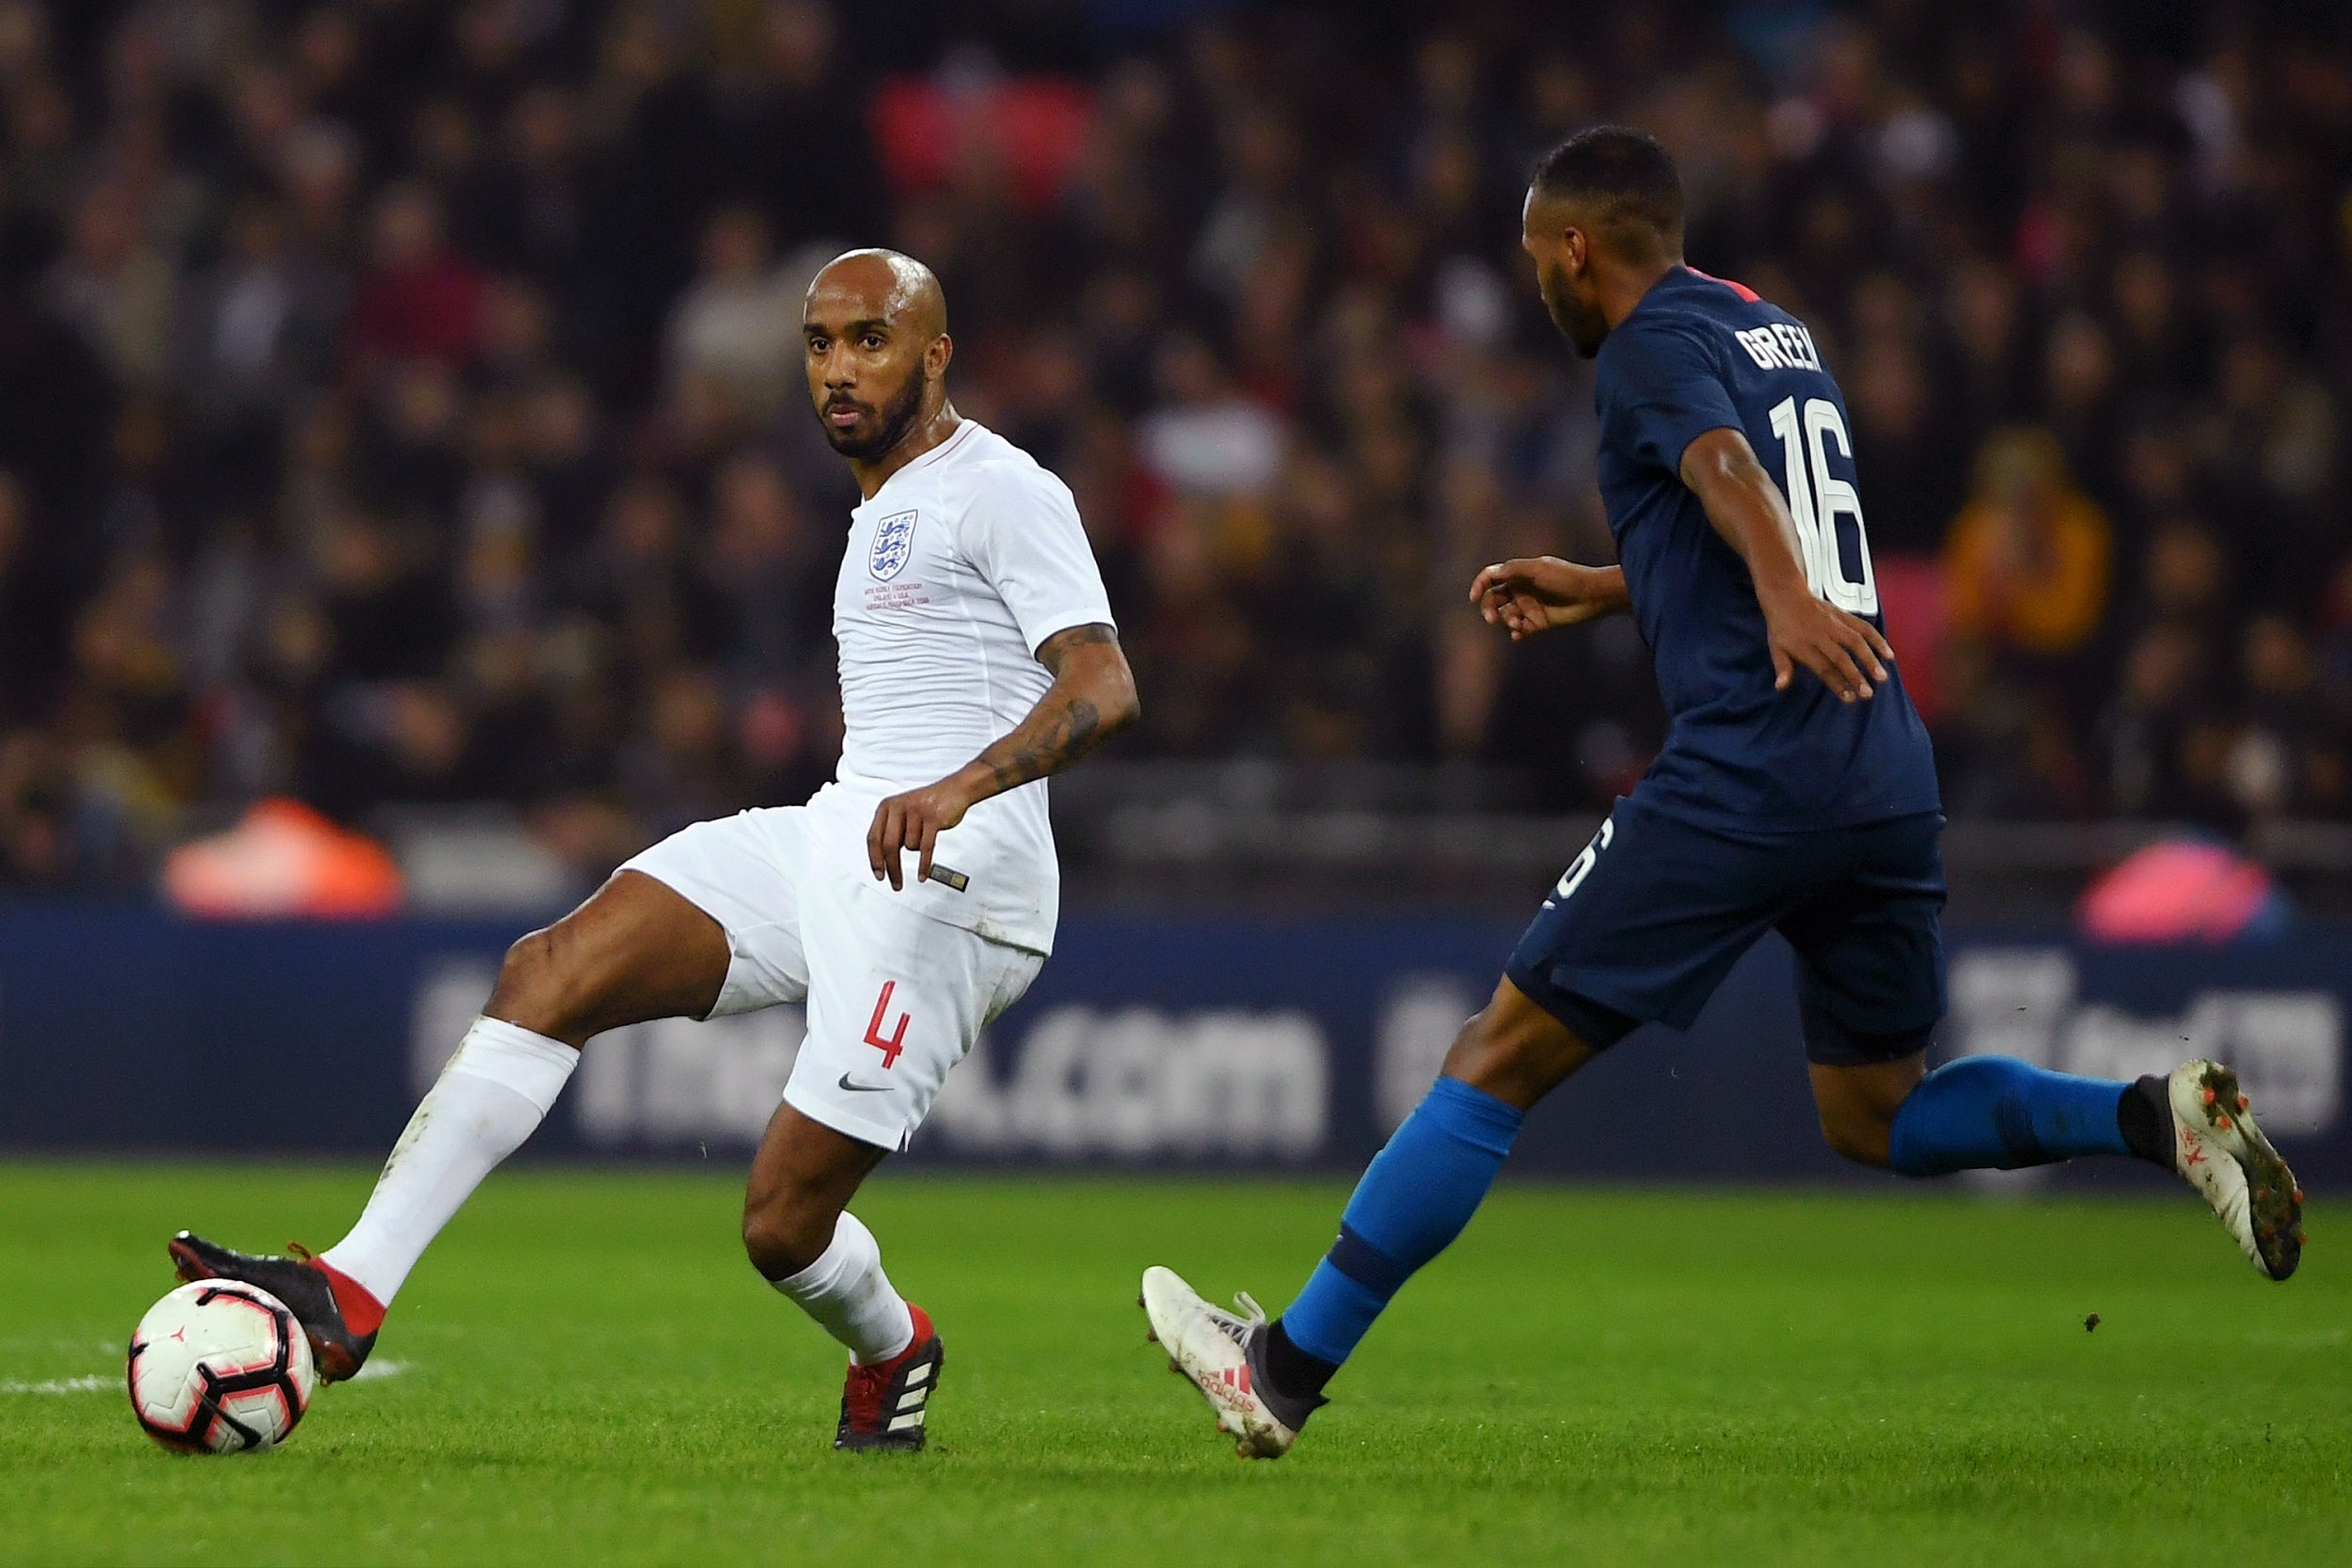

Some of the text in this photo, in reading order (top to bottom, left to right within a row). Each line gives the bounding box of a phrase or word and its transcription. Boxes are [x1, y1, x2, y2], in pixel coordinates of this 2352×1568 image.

[1734, 323, 1823, 373] GREEN
[1768, 395, 1878, 617] 16
[863, 979, 912, 1070] 4
[1198, 1372, 1256, 1412] adidas
